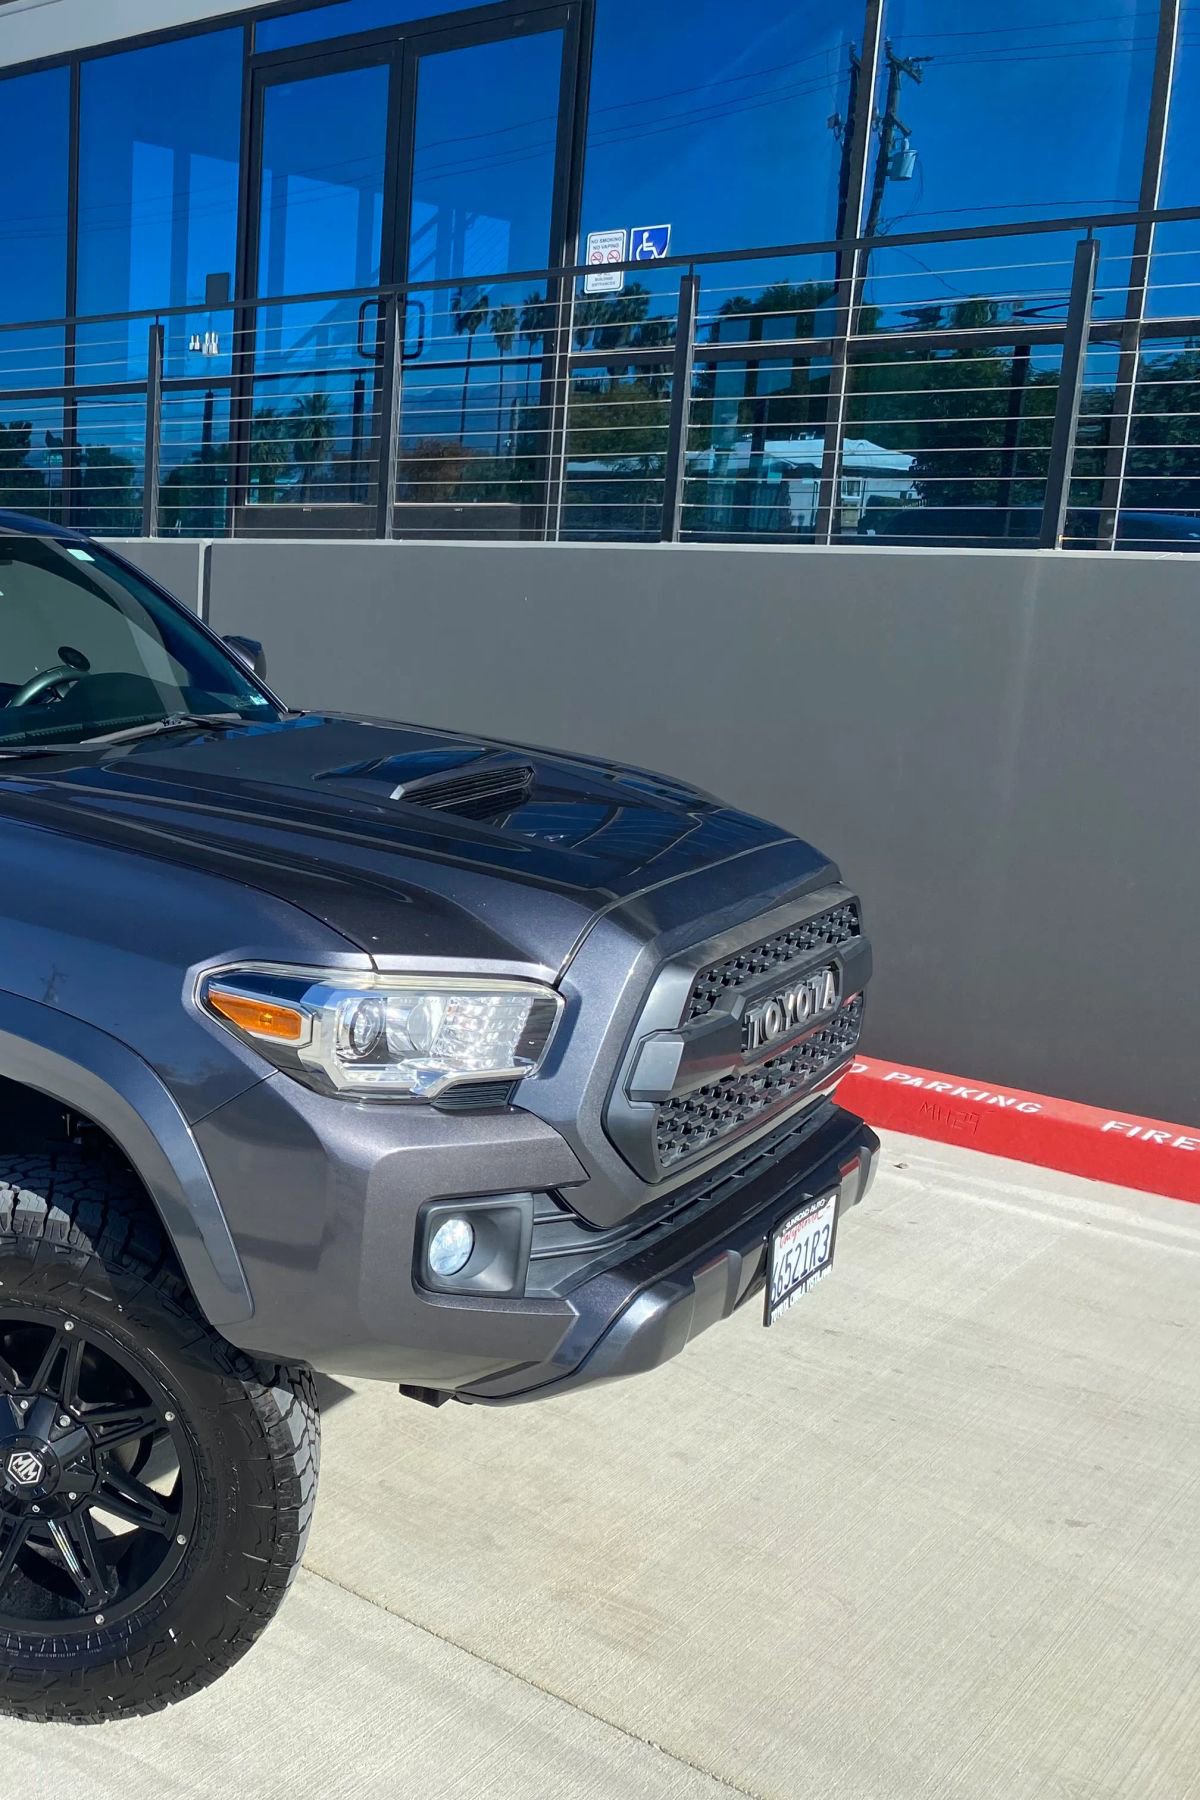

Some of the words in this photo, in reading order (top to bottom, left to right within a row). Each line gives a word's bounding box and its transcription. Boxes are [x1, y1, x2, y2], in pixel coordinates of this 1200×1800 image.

[745, 969, 837, 1050] TOYOTA
[883, 1071, 1042, 1114] PARKING
[1101, 1120, 1200, 1151] FIRE
